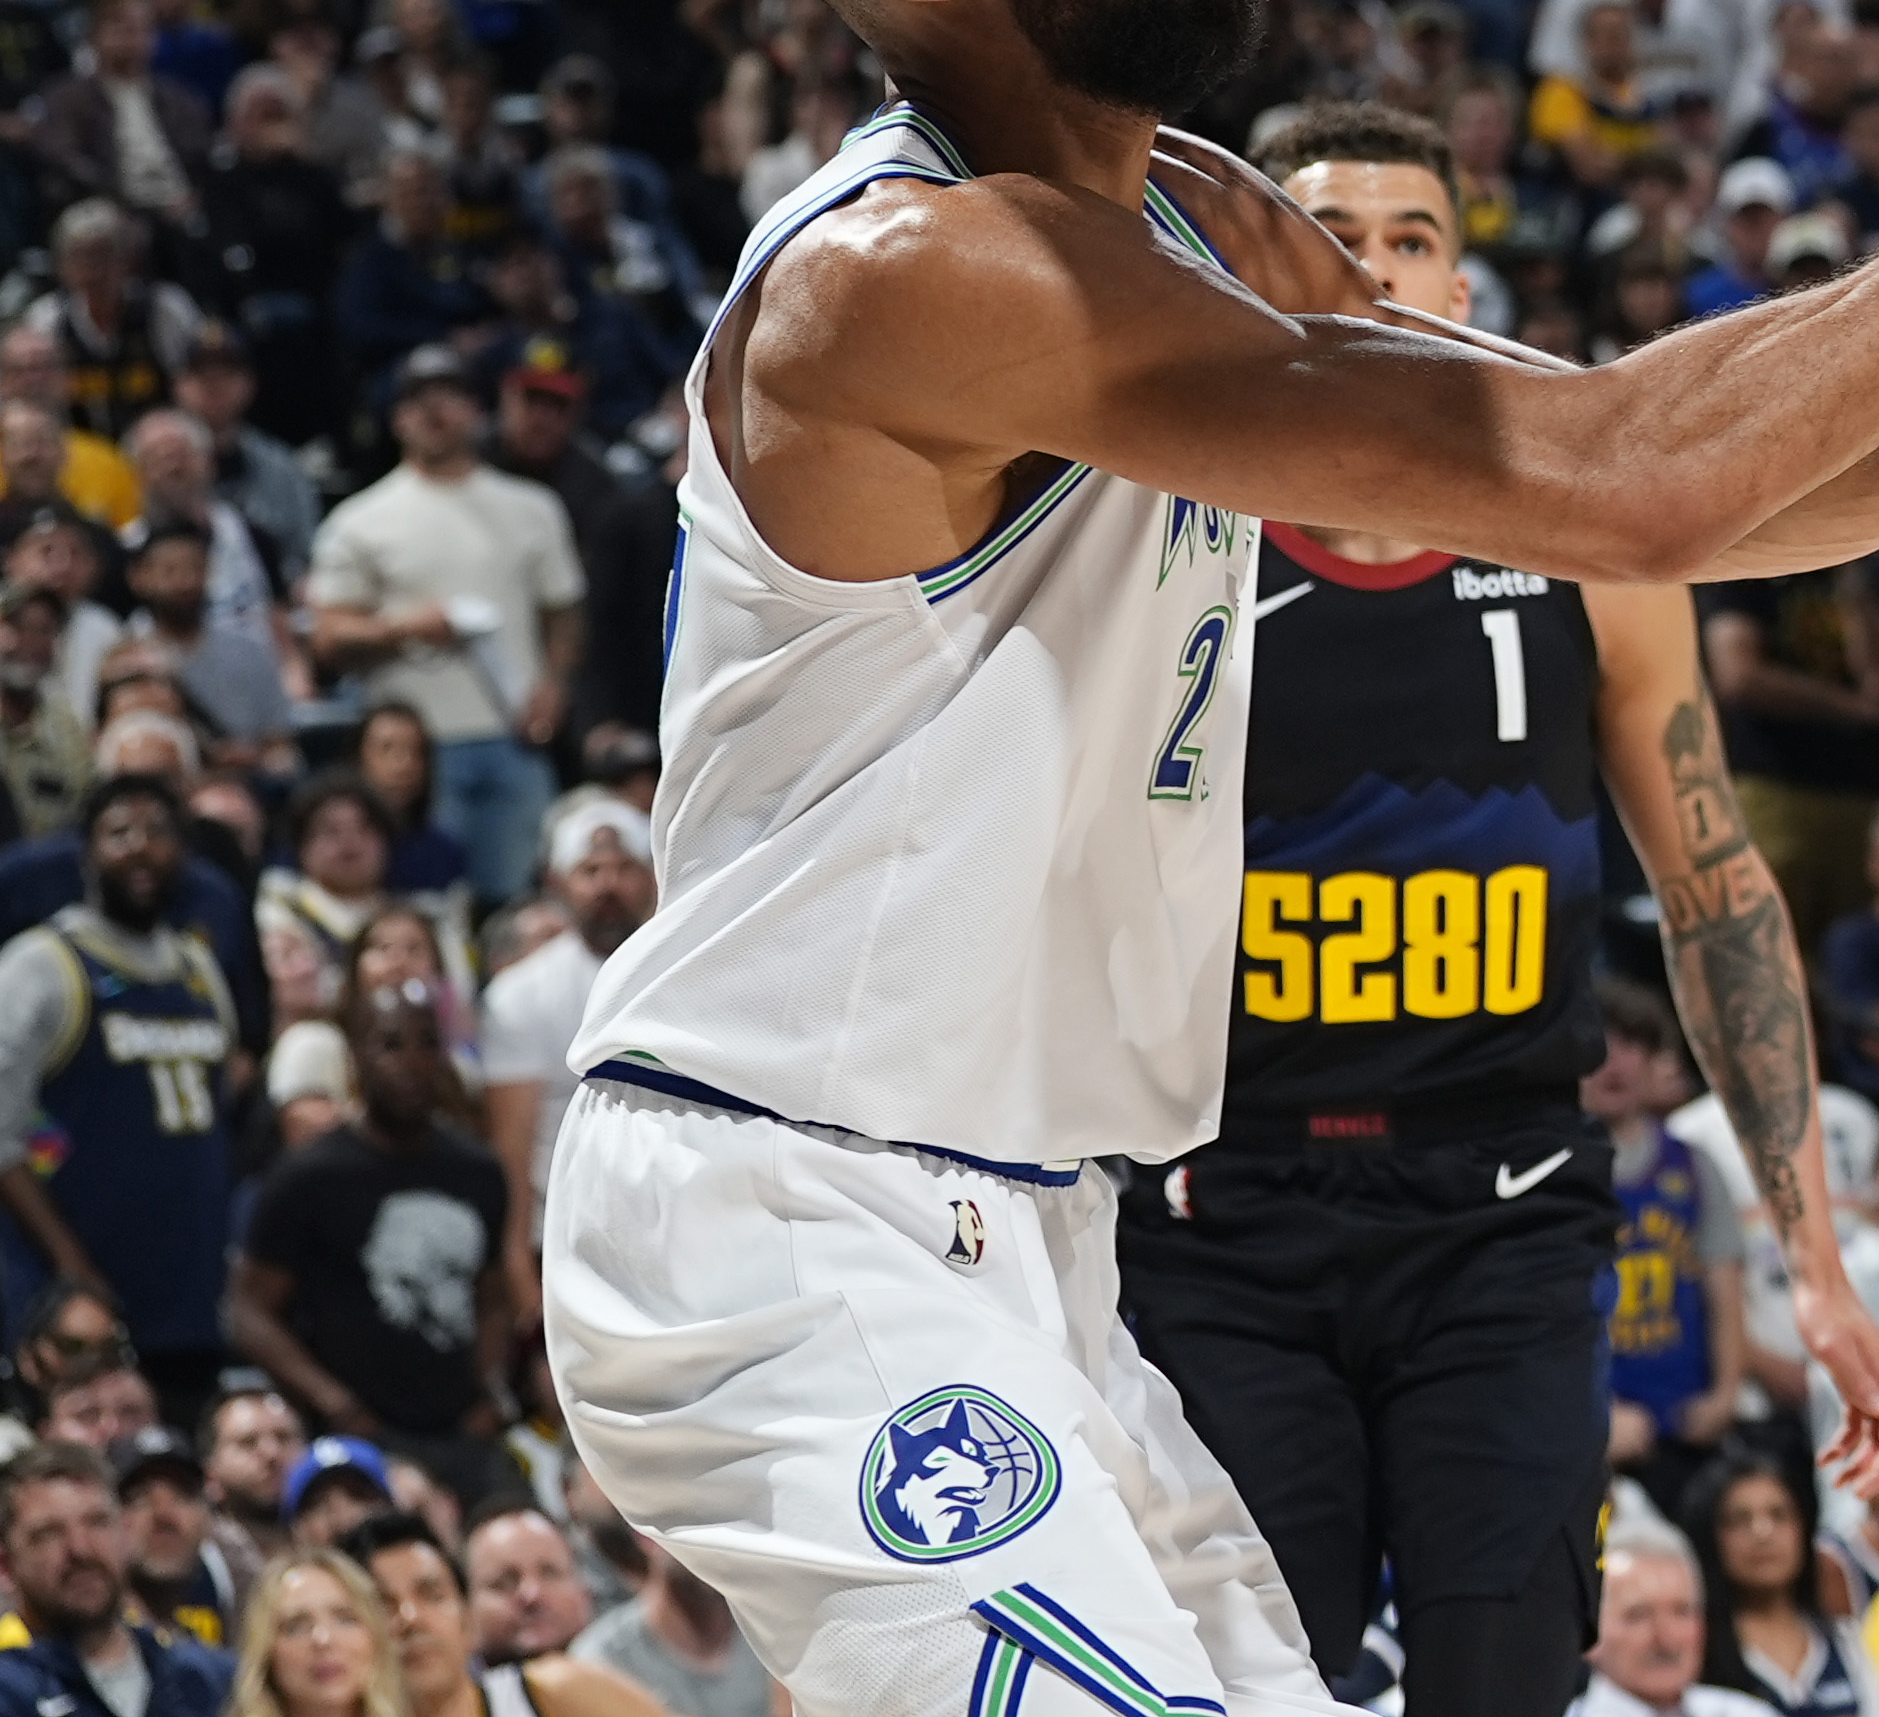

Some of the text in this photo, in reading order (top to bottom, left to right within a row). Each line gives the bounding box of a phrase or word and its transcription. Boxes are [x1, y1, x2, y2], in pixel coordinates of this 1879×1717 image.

[1452, 568, 1549, 601] ibotta
[1147, 604, 1236, 801] 2
[1480, 608, 1527, 742] 1
[1242, 864, 1549, 1024] 5280
